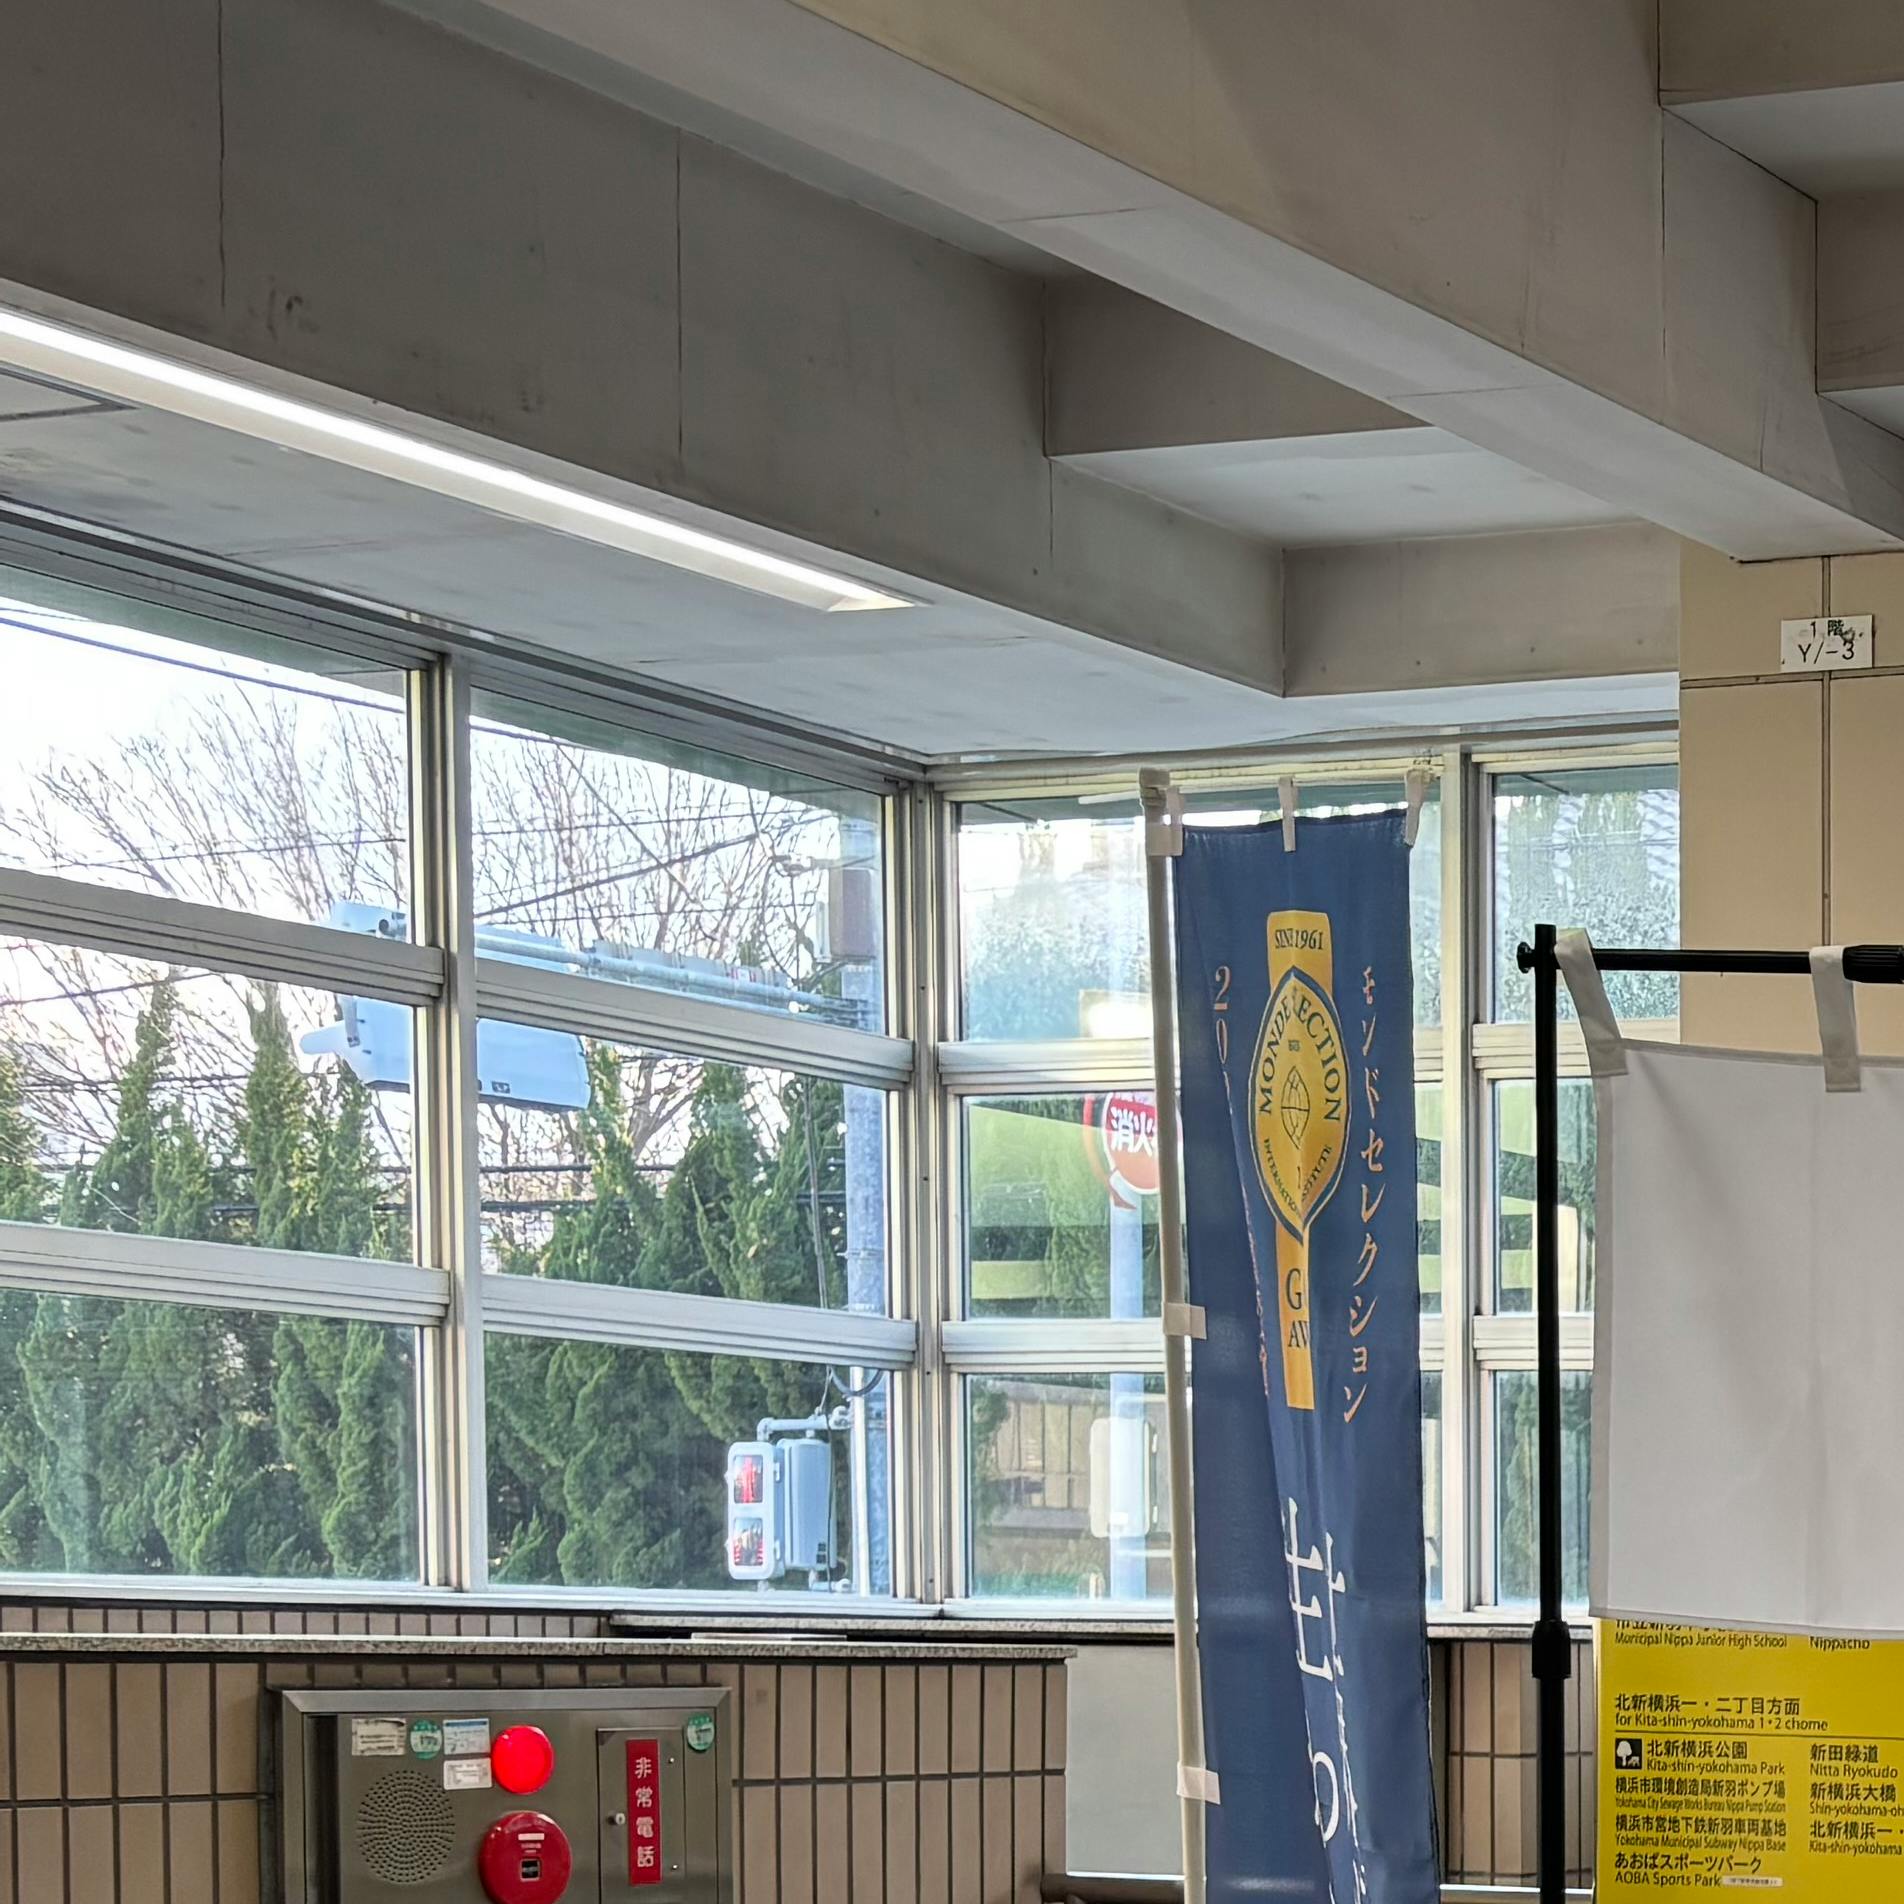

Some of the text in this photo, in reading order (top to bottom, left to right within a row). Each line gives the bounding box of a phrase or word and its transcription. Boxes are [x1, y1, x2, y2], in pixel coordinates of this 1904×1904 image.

[1110, 1105, 1158, 1157] 消火
[1341, 964, 1387, 1424] モンドセレクション
[1728, 1635, 1751, 1650] High
[1754, 1635, 1787, 1648] School
[1615, 1693, 1800, 1717] 北新横浜一・二丁目方面
[1615, 1713, 1828, 1732] for Kita-shin-yokohama chome
[1647, 1739, 1748, 1760] 北新横浜公園
[1809, 1743, 1879, 1764] 新田緑道
[1647, 1759, 1785, 1776] Kita-shin-yokohama Park
[1809, 1763, 1899, 1781] Nitta Ryokudo
[1809, 1781, 1897, 1802] 新横浜大橋
[632, 1755, 657, 1870] 非常電話
[1766, 1838, 1787, 1851] Base
[1614, 1851, 1763, 1875] あおばスポーツパーク
[1614, 1871, 1650, 1885] AOBA
[1653, 1872, 1692, 1888] Sports
[1694, 1873, 1723, 1887] Park
